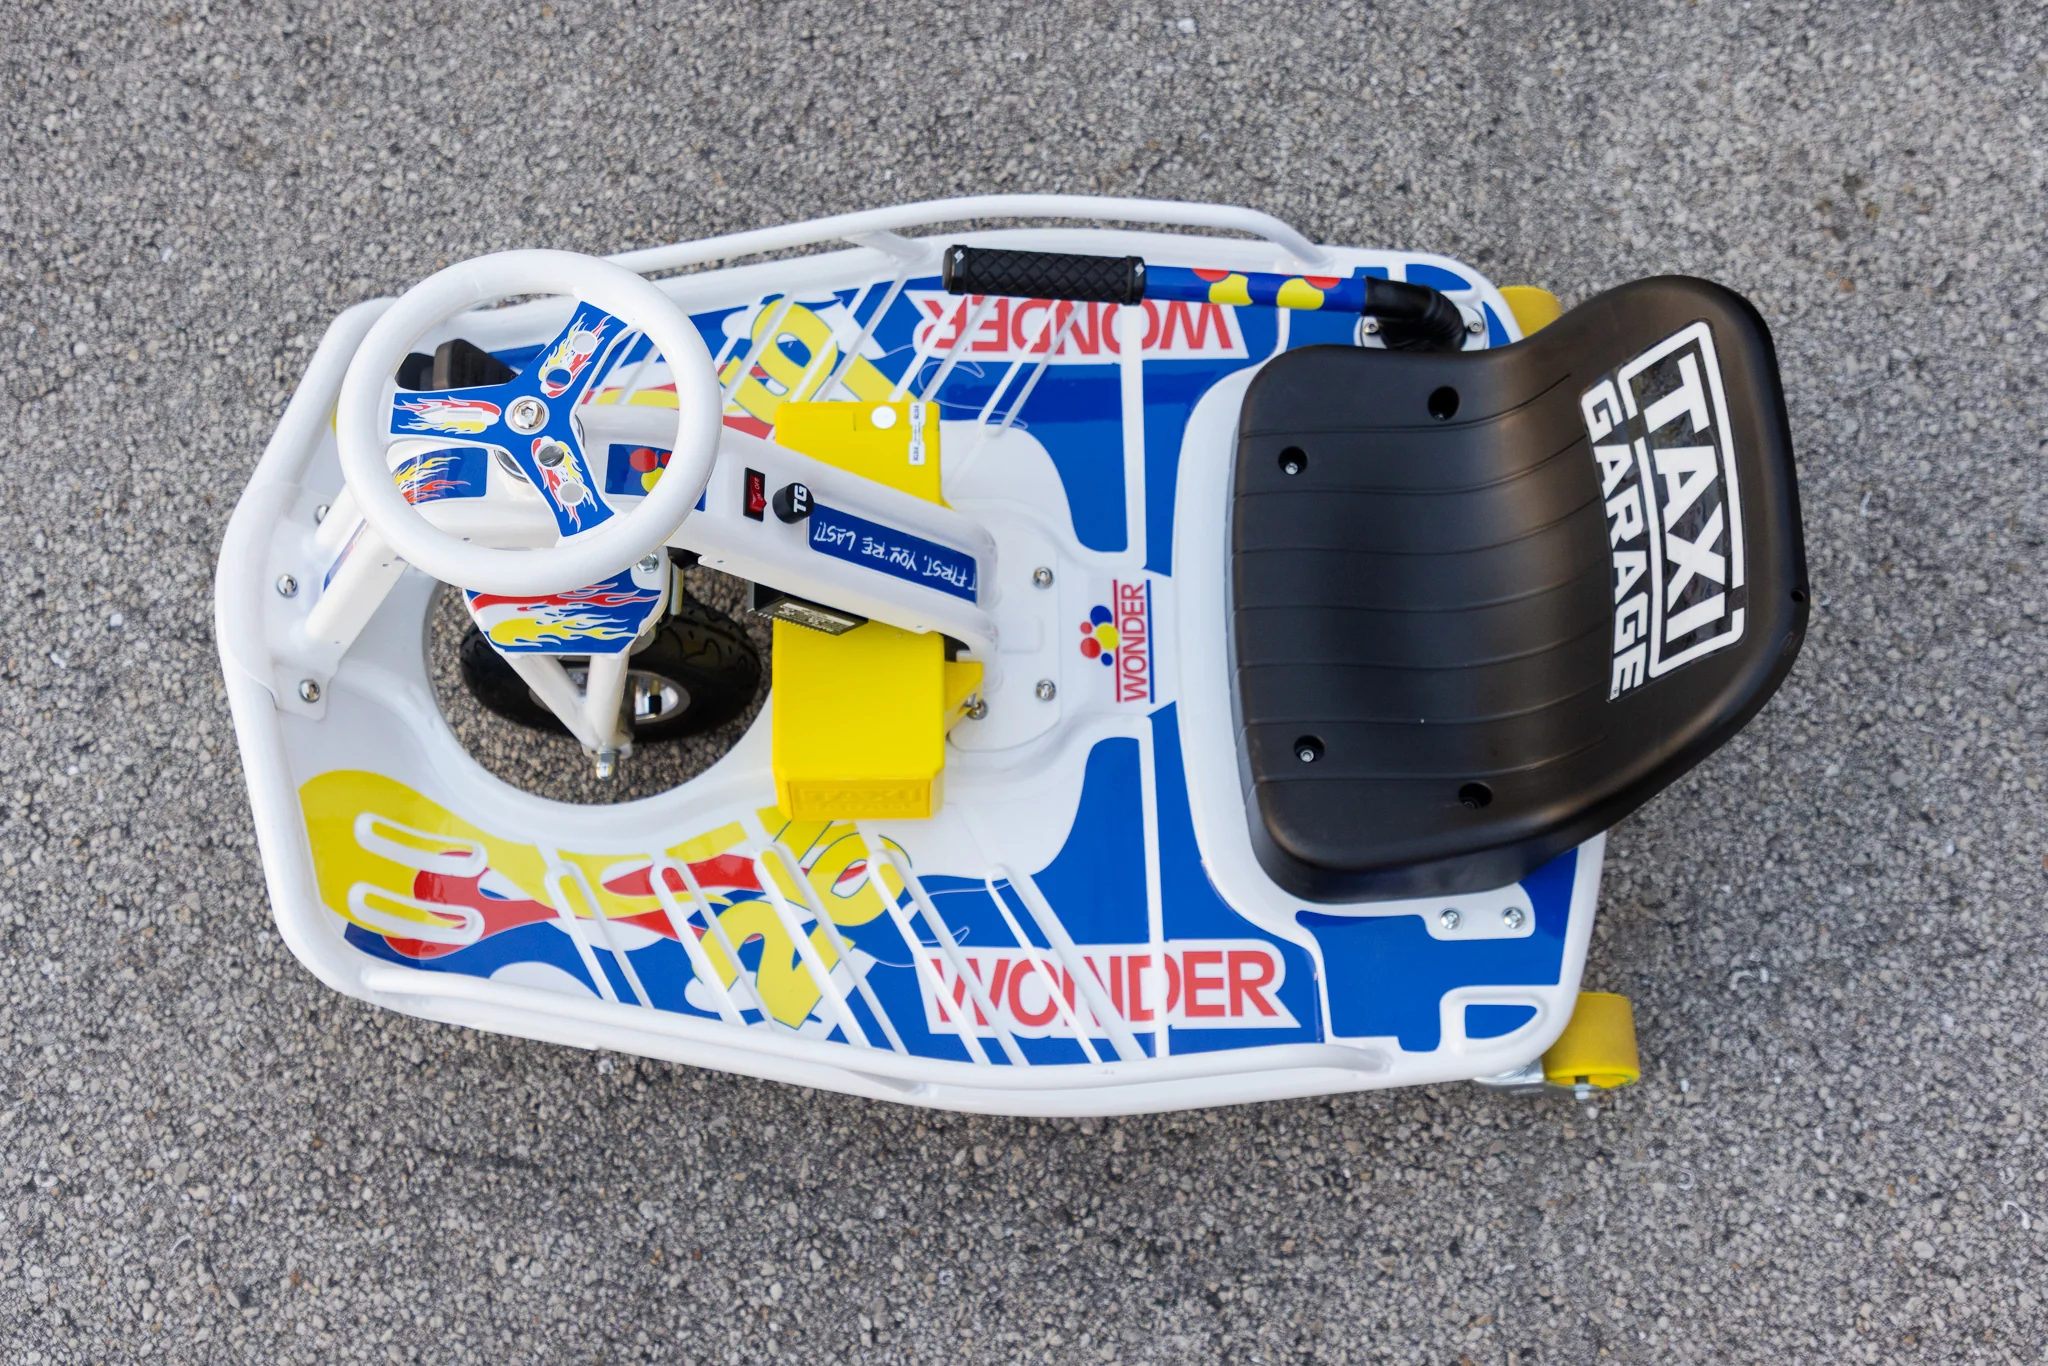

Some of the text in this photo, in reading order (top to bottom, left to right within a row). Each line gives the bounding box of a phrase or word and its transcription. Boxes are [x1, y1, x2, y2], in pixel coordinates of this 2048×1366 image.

[922, 295, 1235, 355] WONDER
[793, 485, 808, 513] TG
[1643, 352, 1727, 643] TAXI
[813, 521, 857, 551] LAST!
[862, 537, 918, 572] YOU'RE
[1581, 378, 1649, 700] GARAGE
[922, 554, 968, 588] FIRST,
[1120, 583, 1148, 702] WONDER
[930, 949, 1280, 1027] WONDER
